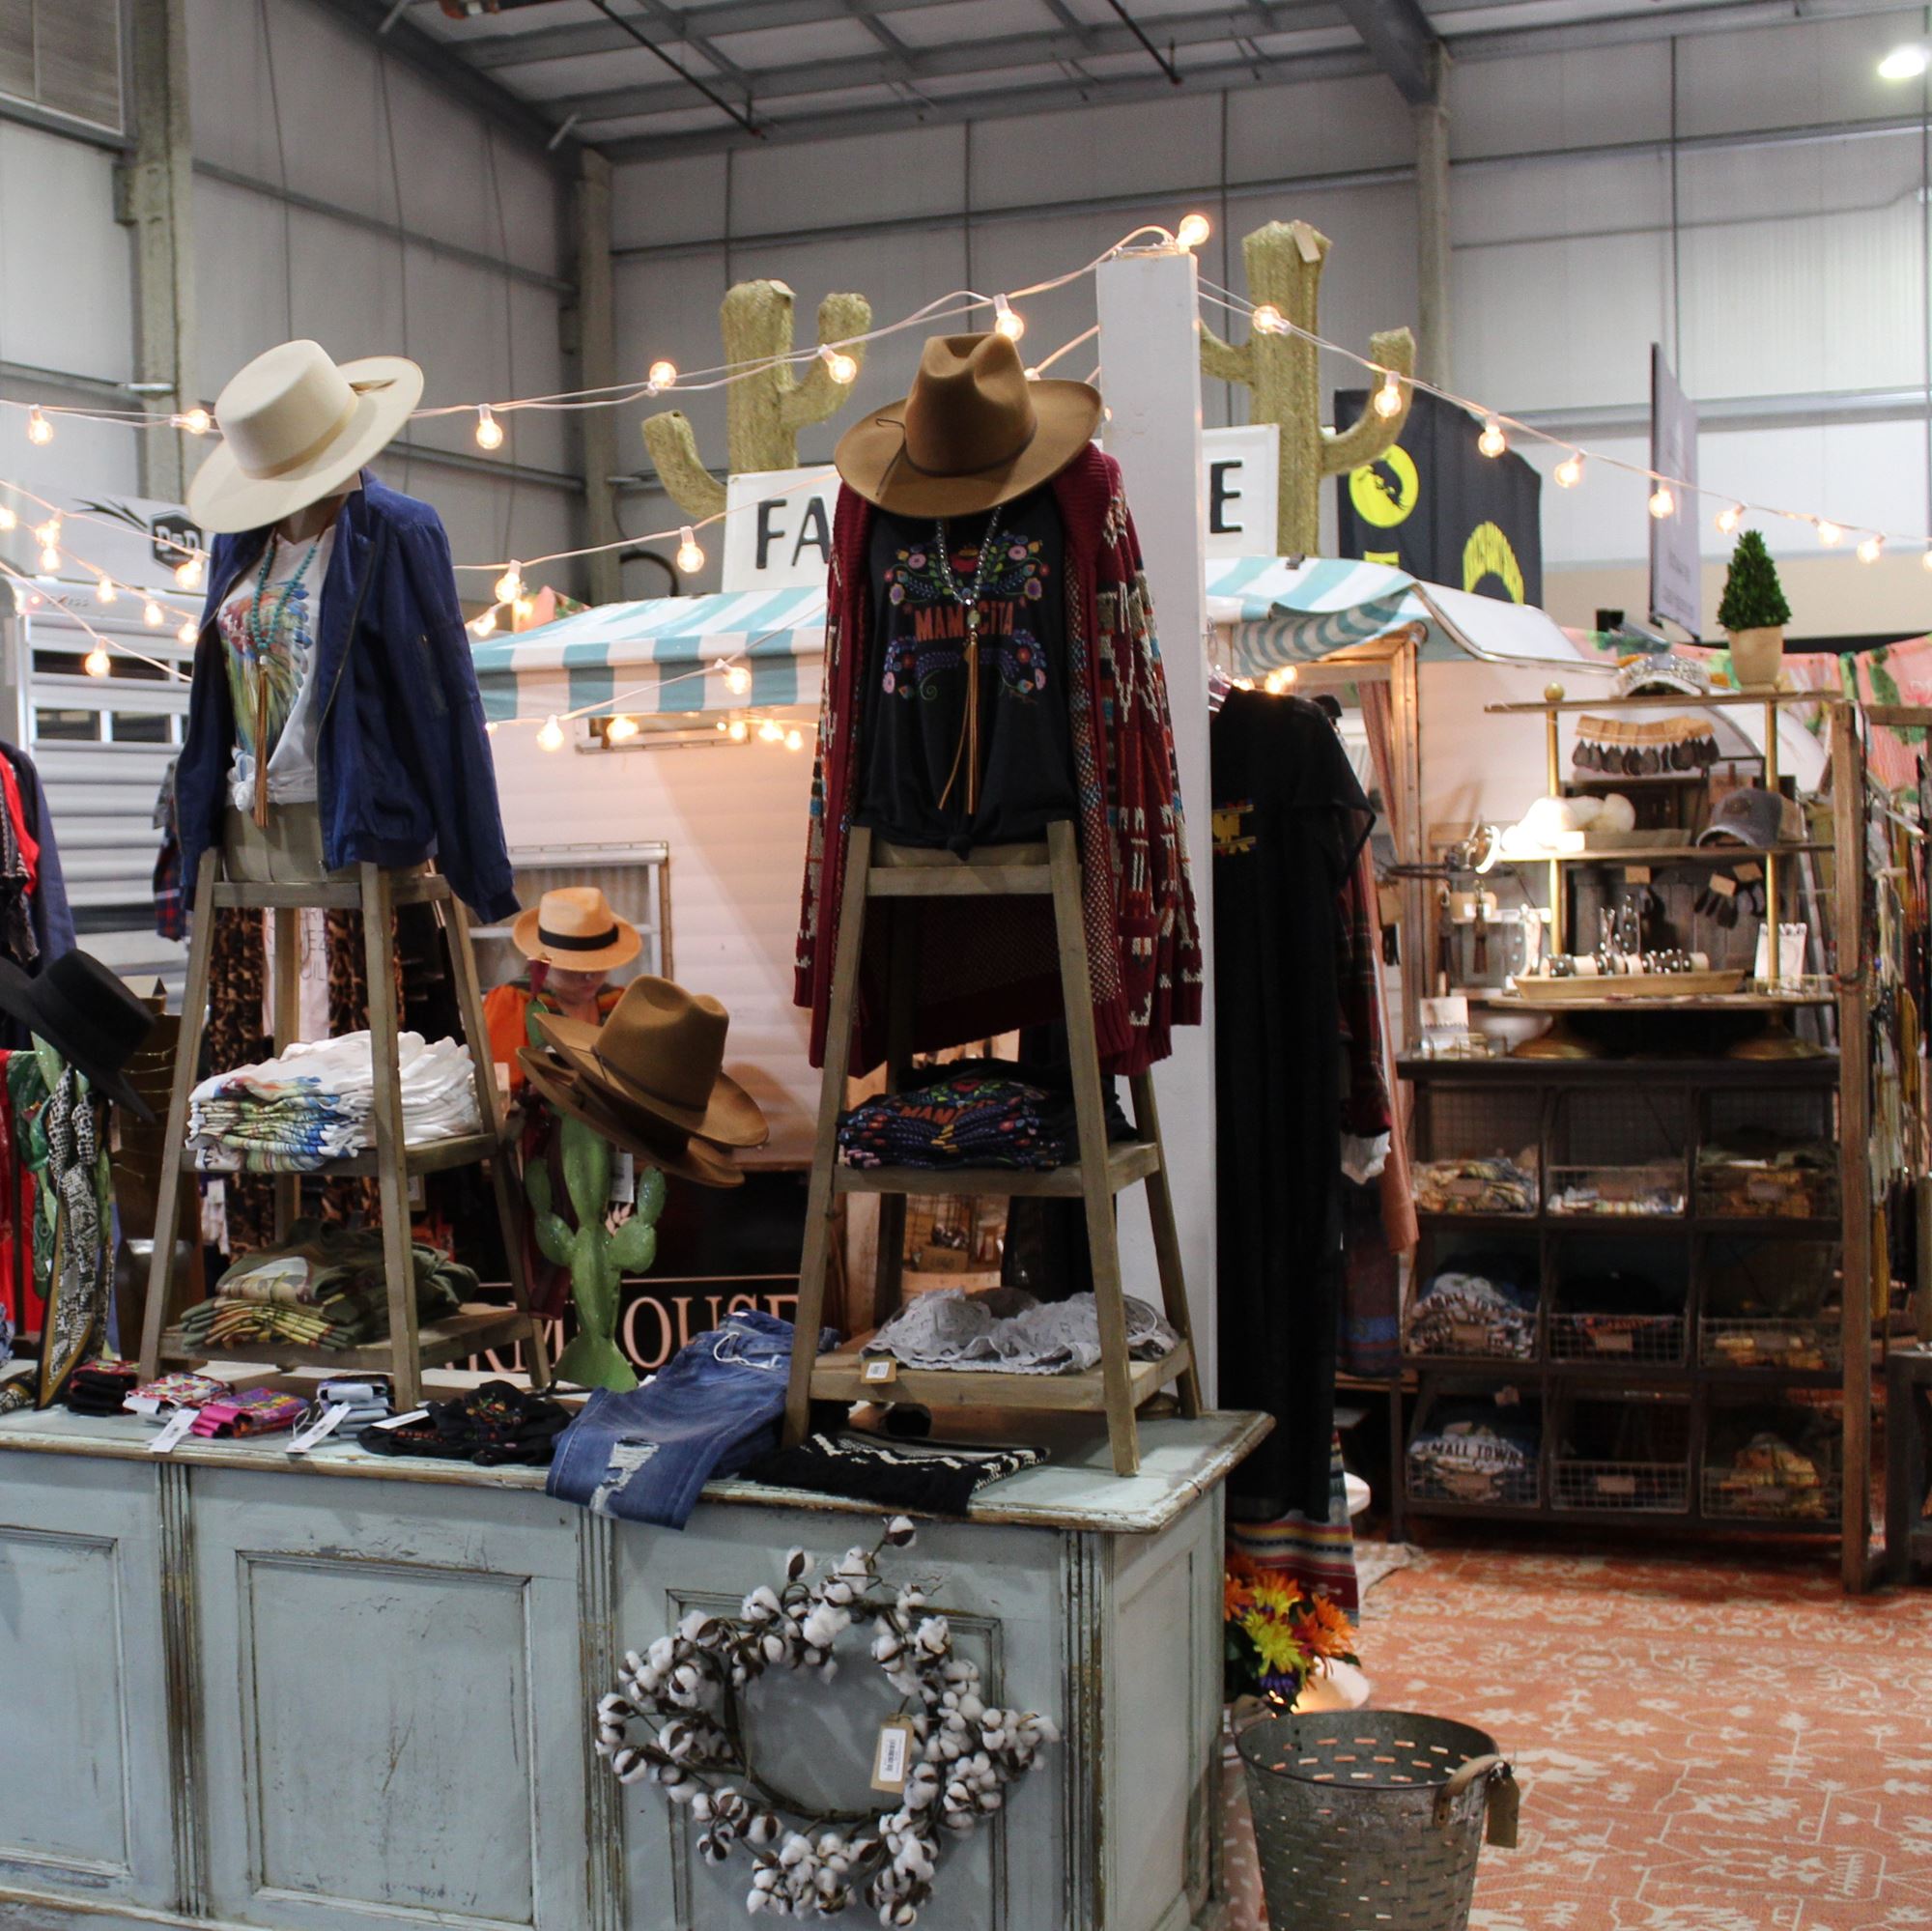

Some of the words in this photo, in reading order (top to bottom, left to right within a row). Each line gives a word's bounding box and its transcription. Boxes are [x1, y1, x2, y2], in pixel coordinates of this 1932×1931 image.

[755, 497, 831, 570] FA
[1209, 461, 1243, 534] E
[914, 600, 1014, 643] MAMCITA
